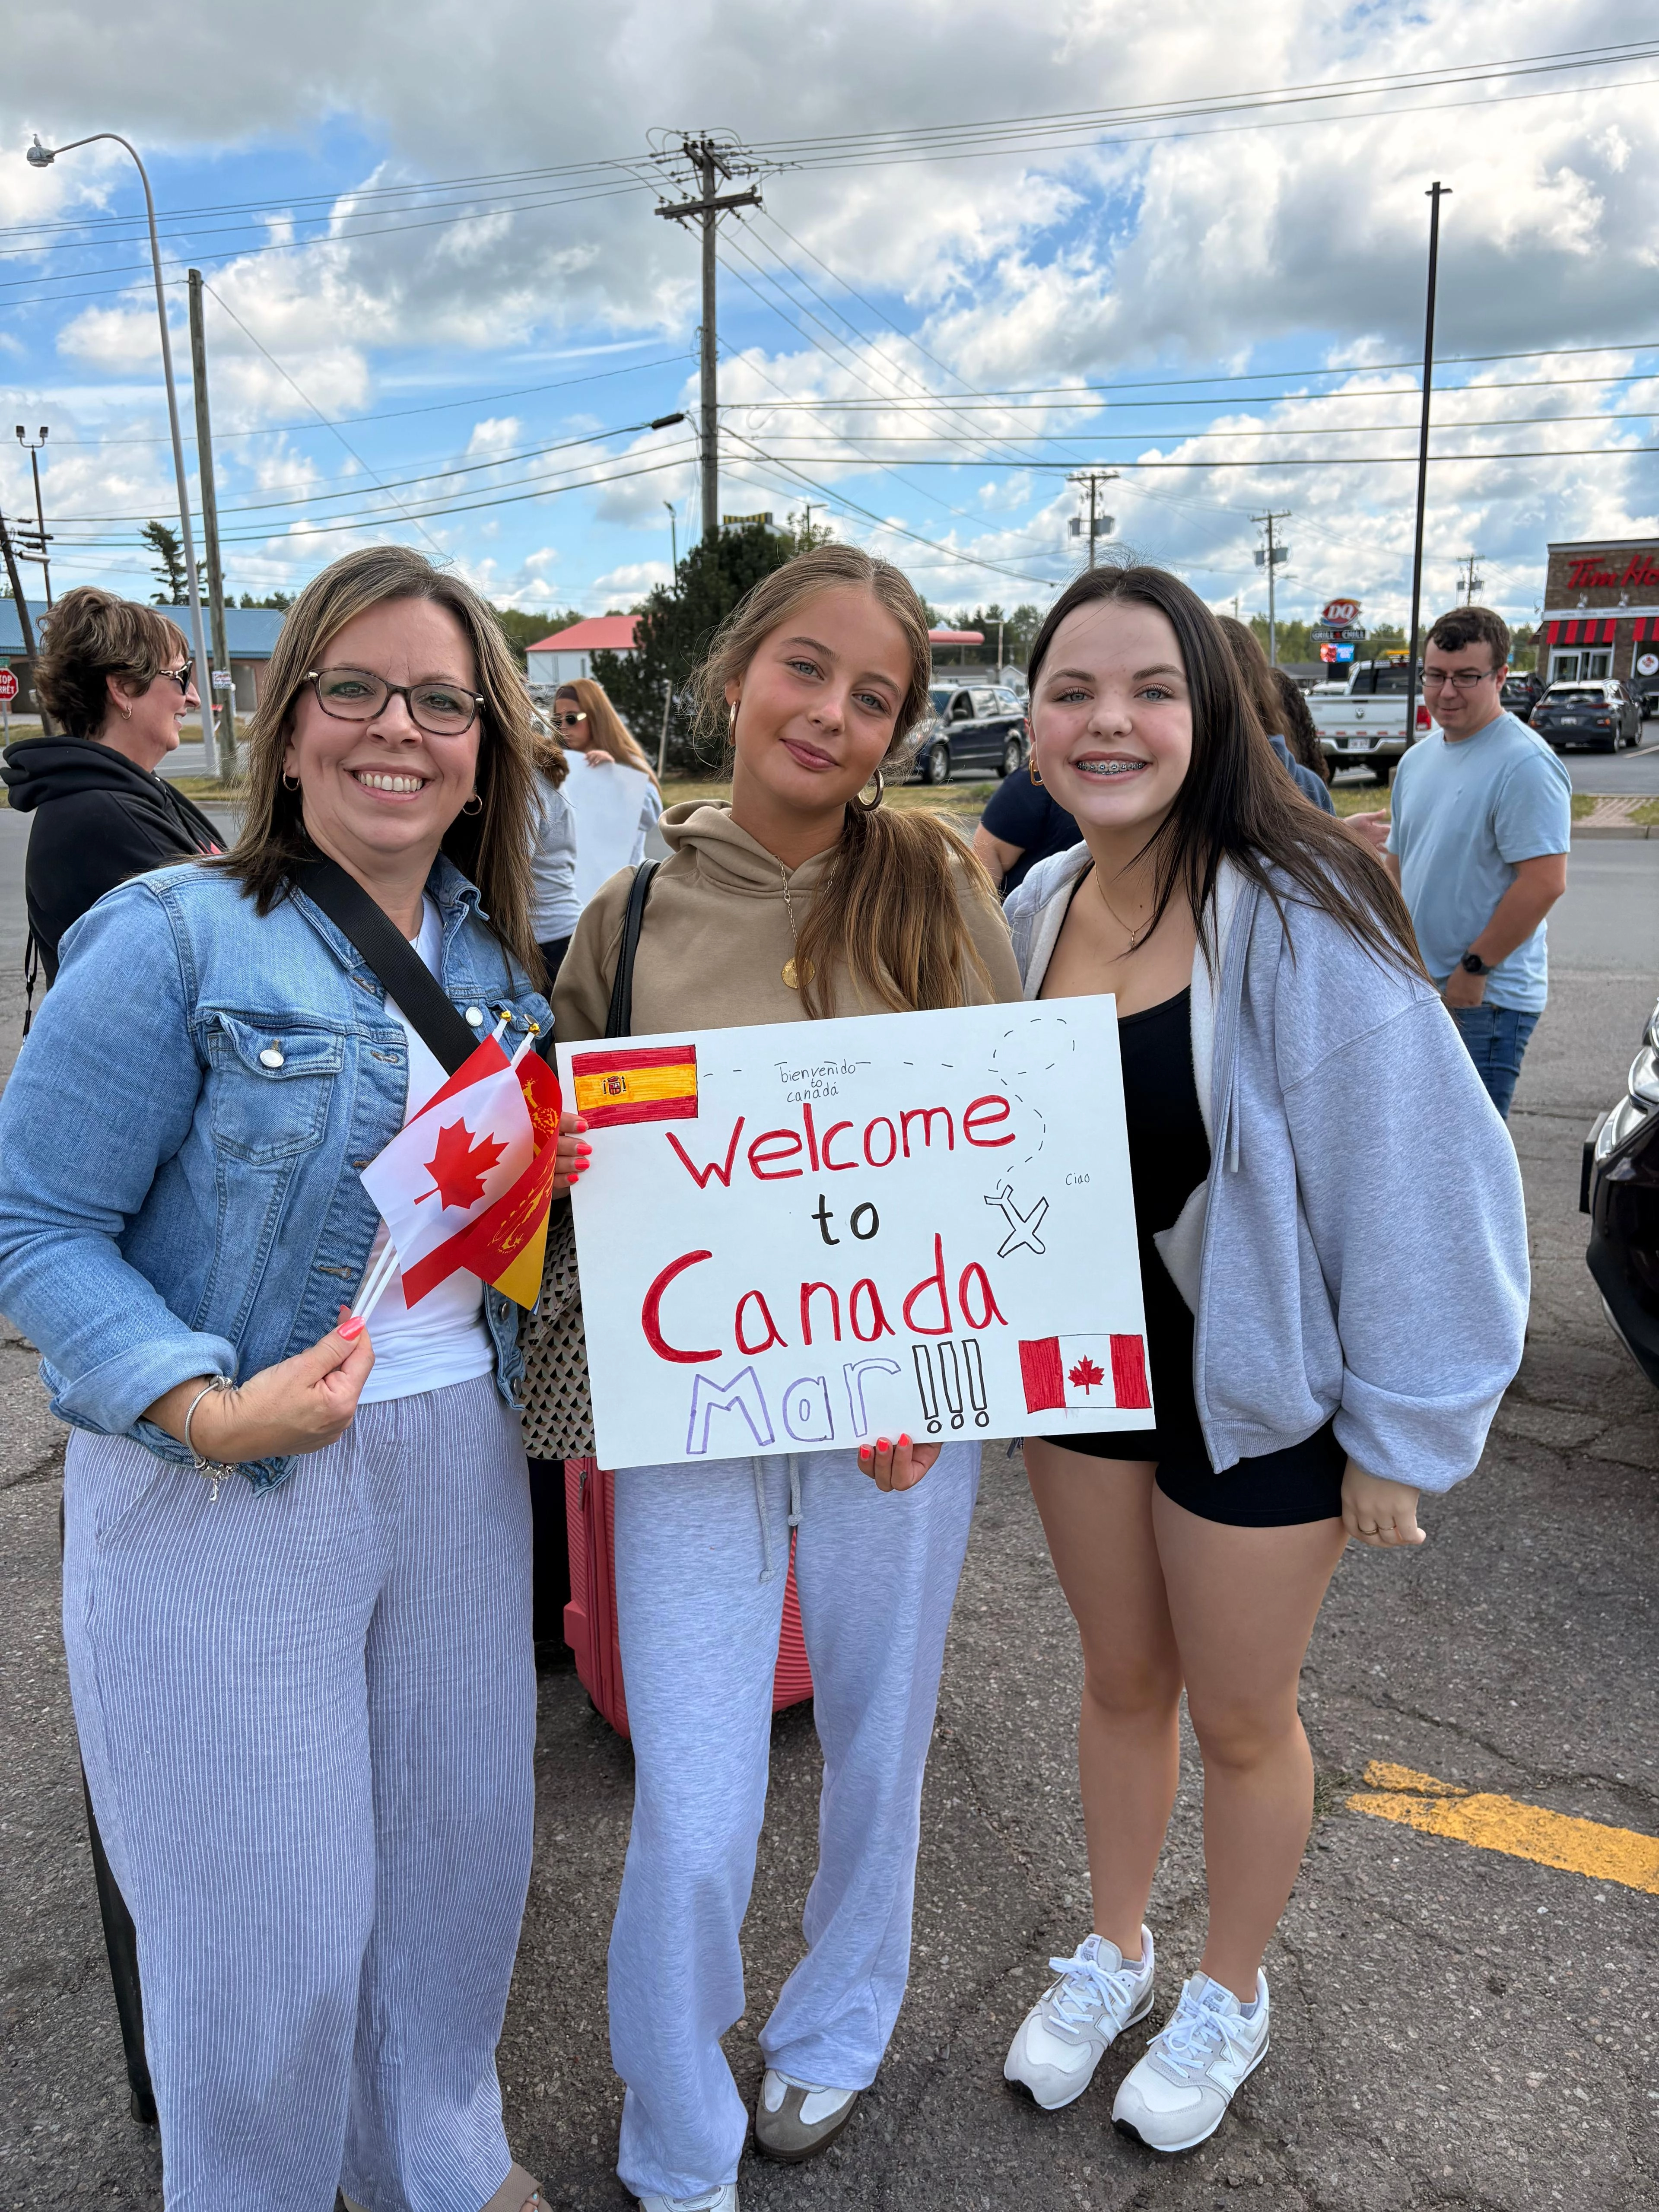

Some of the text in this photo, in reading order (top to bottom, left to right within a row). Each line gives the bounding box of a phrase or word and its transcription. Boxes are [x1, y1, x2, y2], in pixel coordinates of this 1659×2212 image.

[1567, 556, 1618, 590] Tim
[1328, 604, 1354, 620] DQ
[780, 1058, 855, 1083] bienvenido
[811, 1078, 823, 1088] to
[787, 1081, 839, 1103] canadá
[666, 1095, 1016, 1189] Welcome
[1065, 1173, 1090, 1185] Ciao
[811, 1194, 880, 1246] to
[642, 1233, 1008, 1363] Canada
